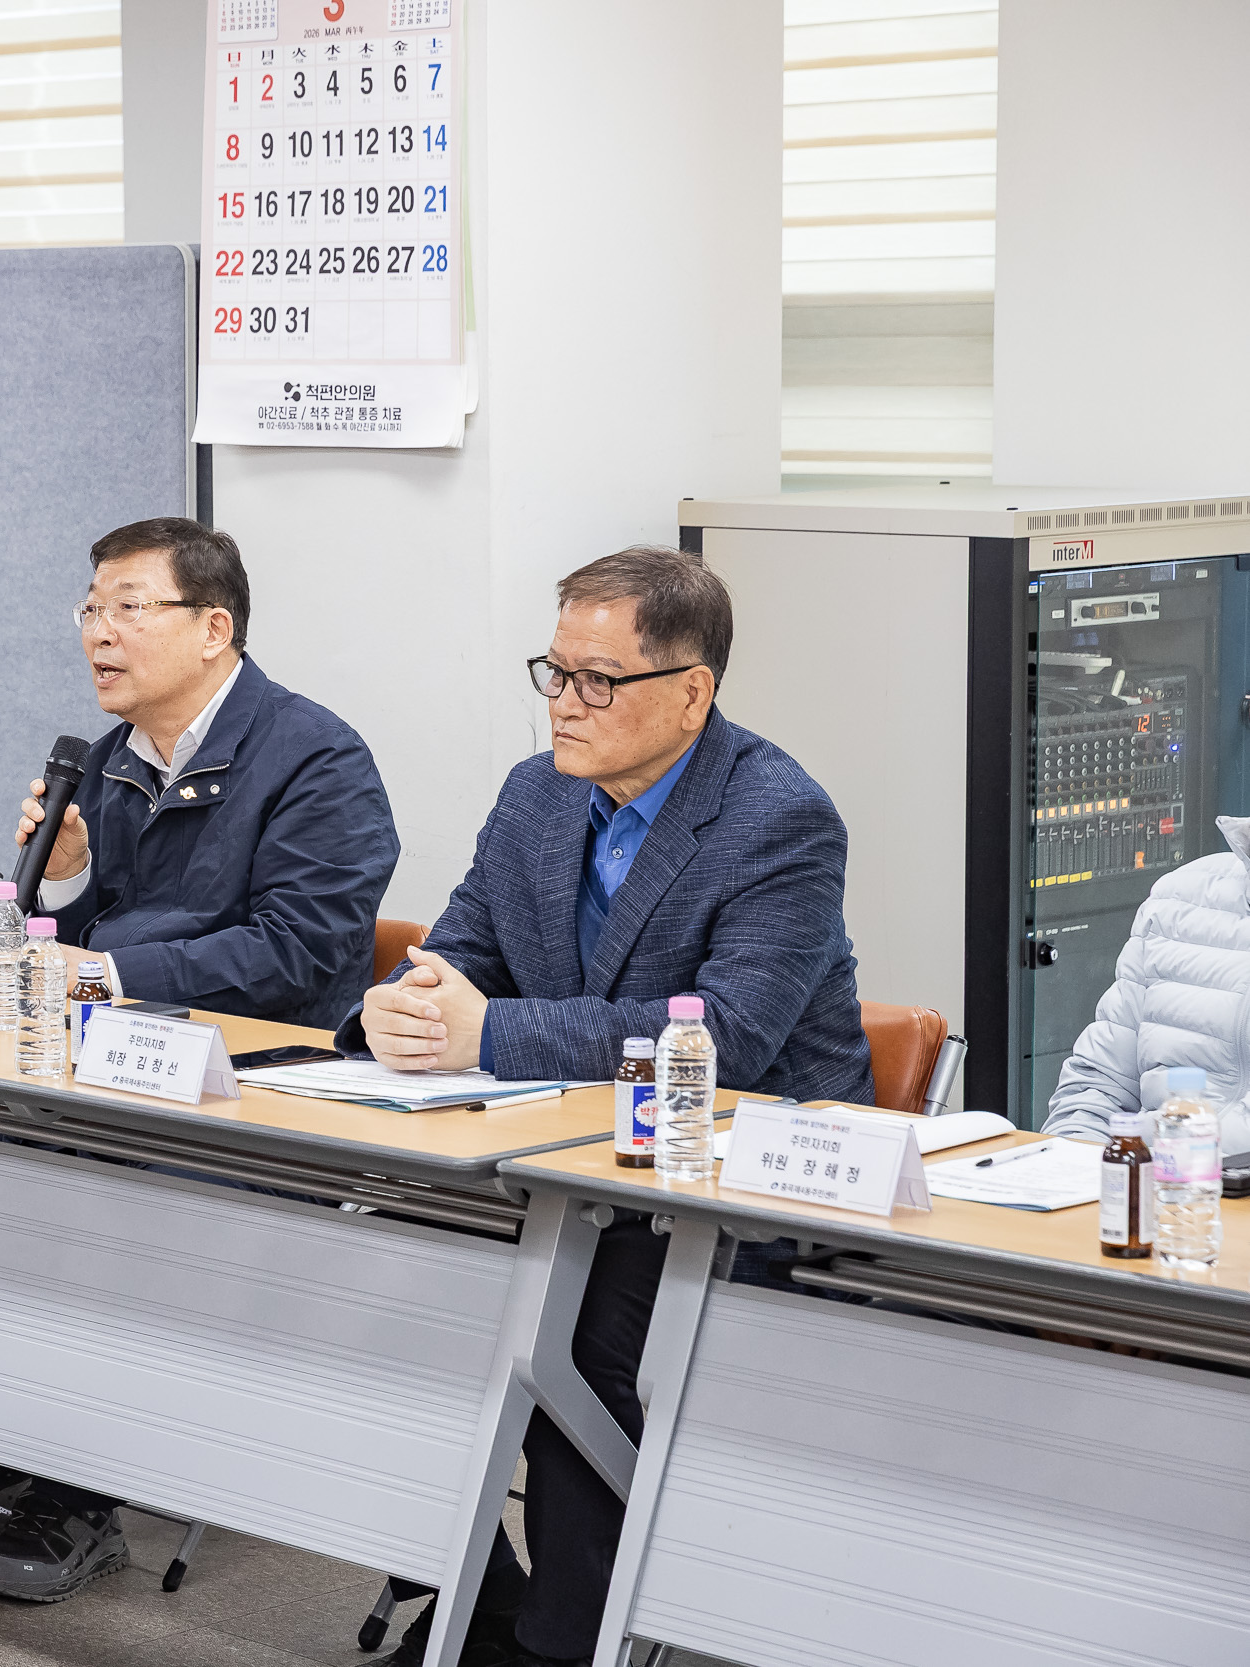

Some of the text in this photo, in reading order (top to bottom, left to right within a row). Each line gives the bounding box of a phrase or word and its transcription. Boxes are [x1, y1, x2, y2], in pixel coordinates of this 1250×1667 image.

[304, 29, 320, 38] 2026
[325, 28, 341, 37] MAR
[292, 47, 307, 58] 火
[325, 44, 341, 55] 水
[358, 43, 374, 53] 木
[230, 64, 441, 102] 1 2 3 4 5 6 7
[227, 125, 447, 160] 8 9 10 11 12 13 14
[219, 186, 446, 218] 15 16 17 18 19 20 21
[216, 245, 447, 276] 22 23 24 25 26 27 28
[215, 307, 309, 333] 29 30 31
[306, 384, 376, 401] 척편안의원
[258, 406, 297, 420] 야간진료
[310, 406, 330, 420] 척추
[334, 406, 354, 421] 관절
[358, 407, 378, 421] 통증
[382, 407, 402, 421] 치료
[266, 422, 314, 430] 02-6953-7588
[350, 422, 376, 431] 야간진료
[378, 422, 402, 432] 9시까지
[1137, 714, 1150, 732] 12
[128, 1034, 166, 1051] 주민자치회
[106, 1049, 127, 1067] 회장
[790, 1134, 841, 1154] 주민자치회
[760, 1152, 789, 1171] 위원
